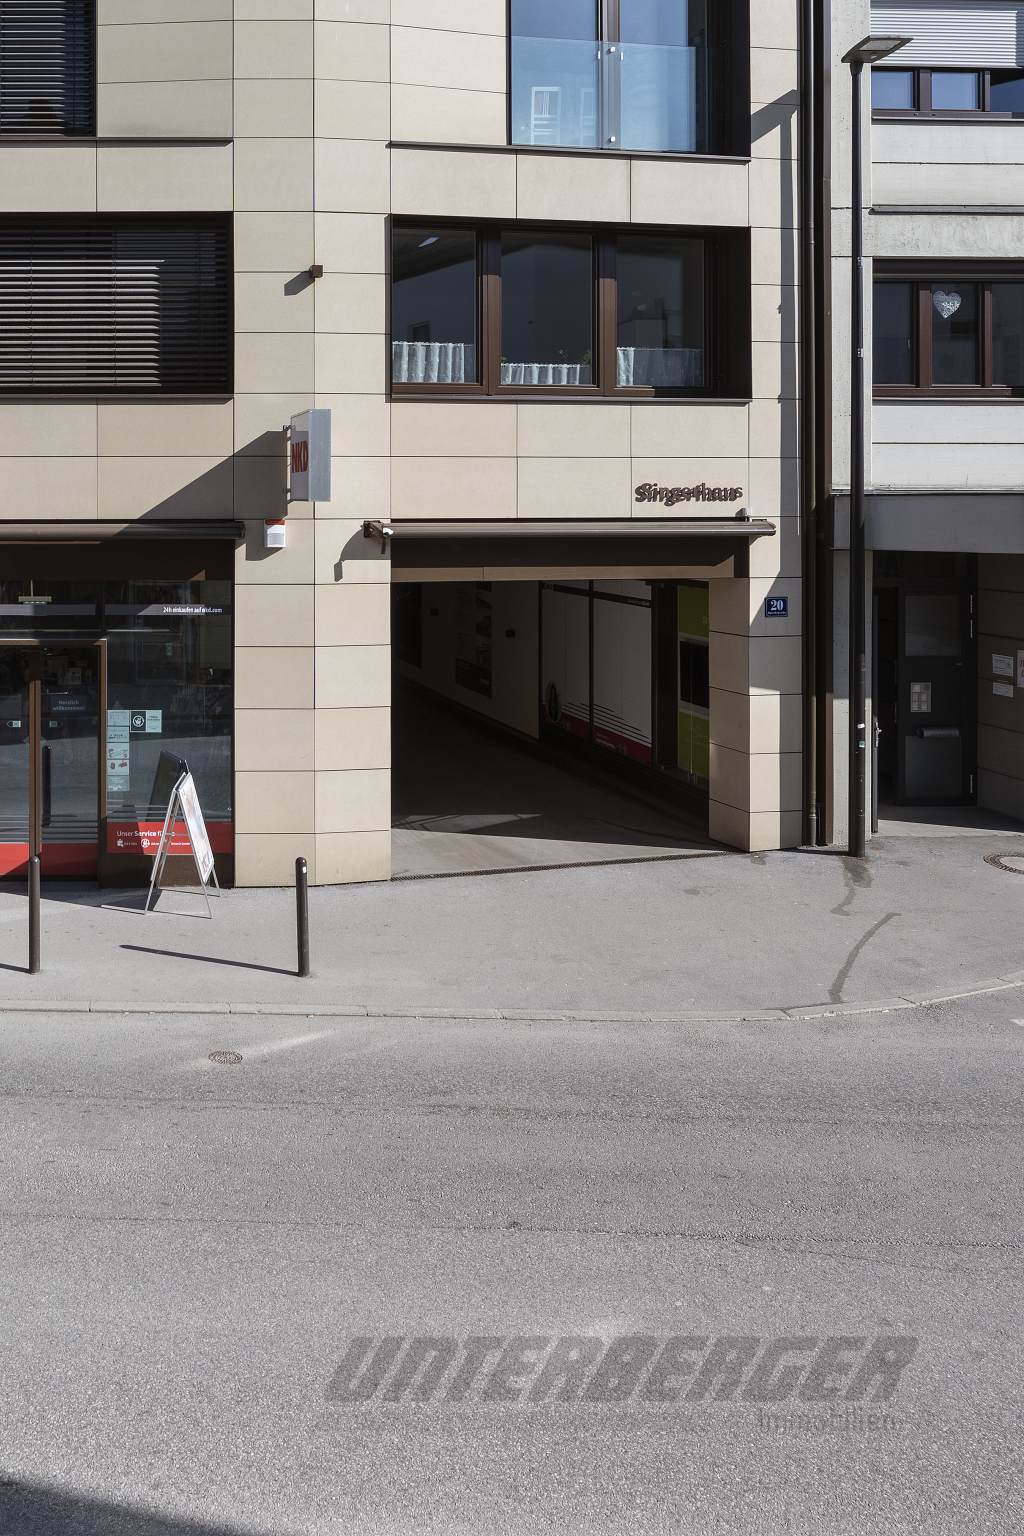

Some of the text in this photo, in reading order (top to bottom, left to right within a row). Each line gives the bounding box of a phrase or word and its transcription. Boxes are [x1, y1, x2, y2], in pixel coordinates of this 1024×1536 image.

[291, 440, 309, 474] NKD
[635, 482, 744, 506] Singerhaus
[770, 600, 785, 611] 20
